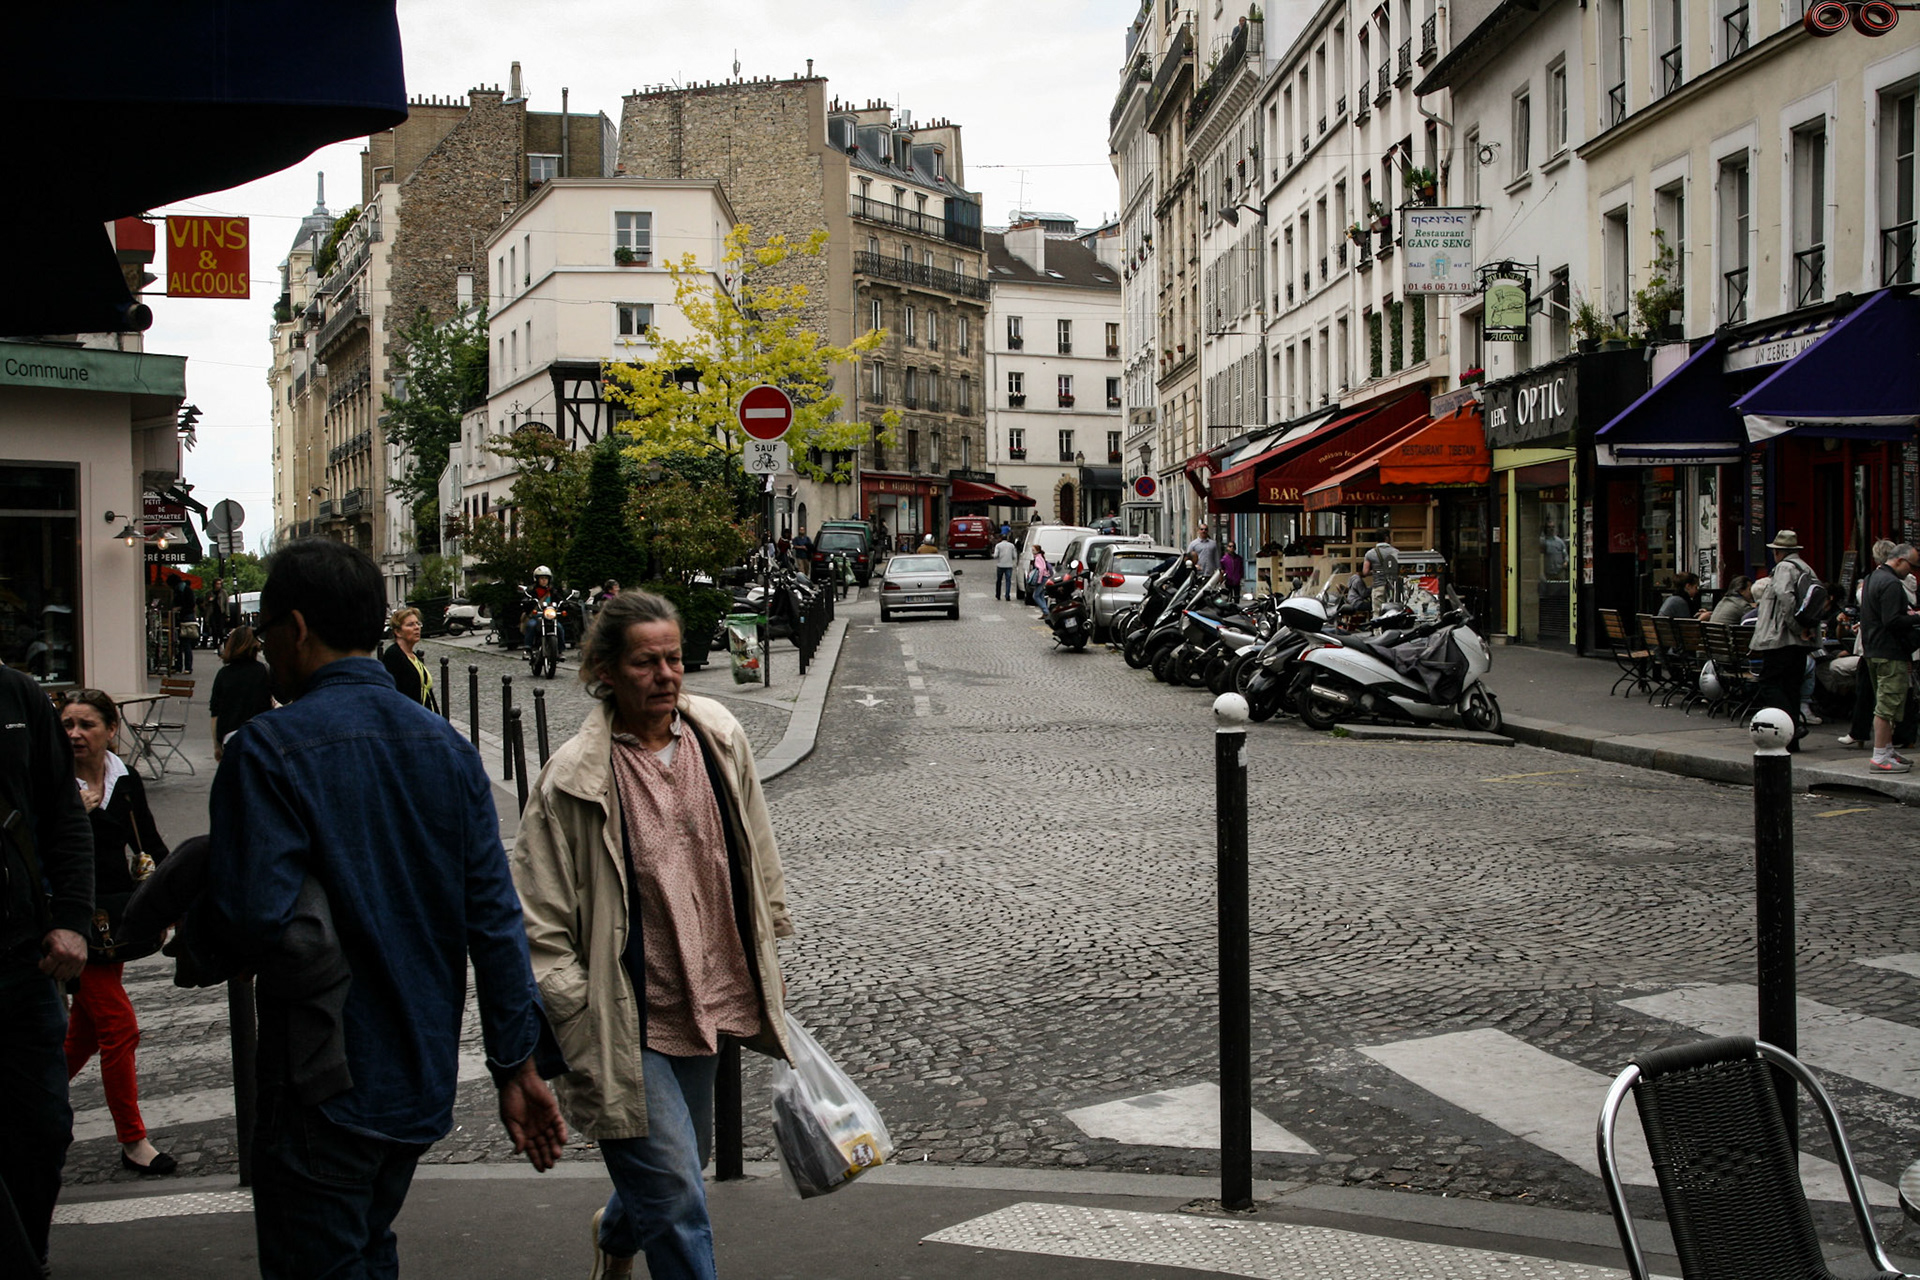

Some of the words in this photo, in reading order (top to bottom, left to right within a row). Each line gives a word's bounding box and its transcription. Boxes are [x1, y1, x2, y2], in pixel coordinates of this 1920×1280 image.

[169, 219, 247, 250] VINS
[1415, 229, 1465, 238] Restaurant
[1407, 239, 1439, 248] GANG
[1442, 239, 1471, 248] SENG
[198, 250, 217, 270] &
[169, 272, 247, 295] ALCOOLS
[1408, 283, 1418, 291] 01
[1422, 283, 1432, 291] 46
[1435, 283, 1445, 291] 06
[1449, 283, 1458, 291] 71
[1461, 283, 1471, 291] 91
[1755, 347, 1765, 364] UN
[5, 358, 89, 381] Commune
[1517, 378, 1565, 426] OPTIC
[1490, 406, 1508, 428] LEPIC
[755, 444, 778, 452] SAUF
[1318, 451, 1343, 464] maison
[1269, 487, 1300, 501] BAR
